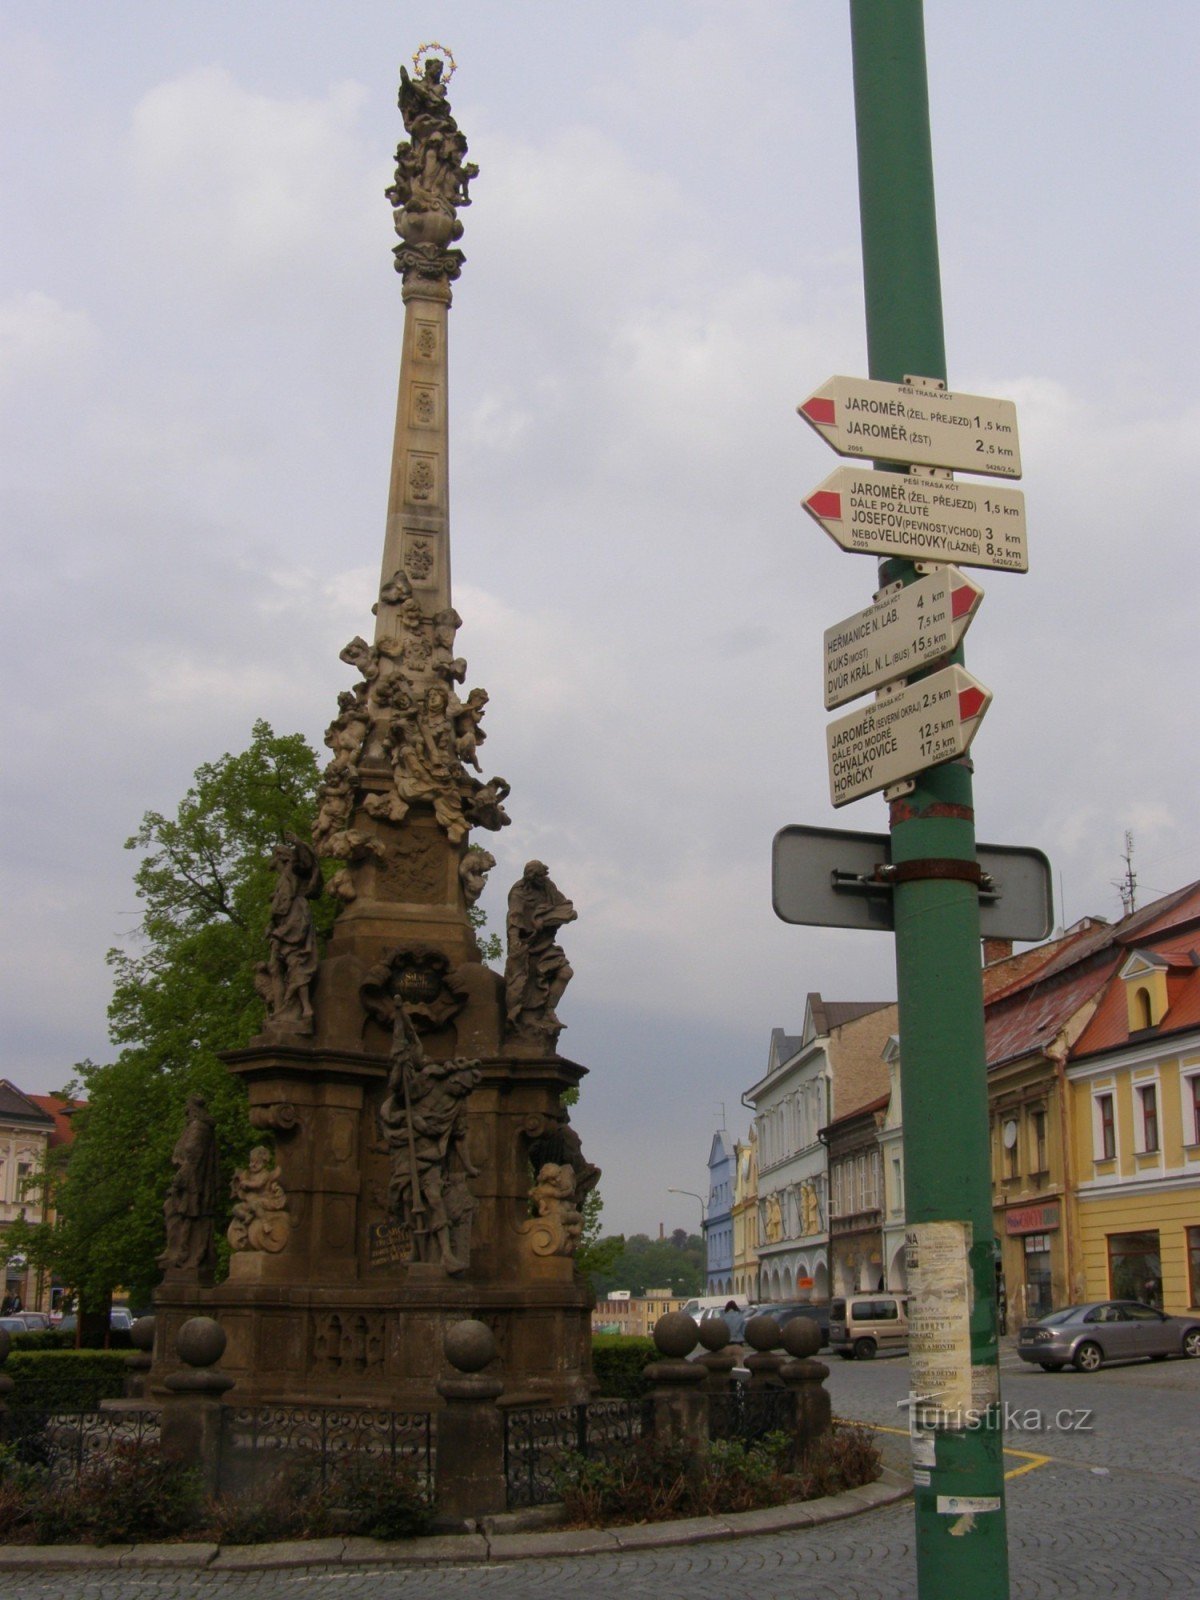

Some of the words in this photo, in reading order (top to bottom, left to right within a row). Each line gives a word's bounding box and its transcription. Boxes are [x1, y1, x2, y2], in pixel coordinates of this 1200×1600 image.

[915, 390, 938, 398] TRASA
[845, 397, 906, 417] JAROMĚŘ
[906, 408, 928, 420] (ŽEL.
[930, 412, 972, 428] PŘEJEZD)
[996, 422, 1011, 432] km
[847, 421, 907, 441] JAROMĚŘ
[910, 432, 932, 446] (ŽST)
[976, 440, 995, 454] 2,5
[998, 446, 1013, 456] km
[851, 482, 906, 500] JAROMĚŘ
[908, 491, 930, 502] (ŽEL.
[933, 495, 976, 512] PŘEJEZD)
[984, 500, 1000, 514] 1,5
[1004, 506, 1019, 516] km
[922, 480, 944, 488] TRASA
[850, 497, 877, 510] DÁLE
[880, 502, 895, 512] PO
[897, 502, 929, 516] ŽLUTÉ
[852, 510, 902, 528] JOSEFOV
[986, 528, 993, 540] 3
[1005, 533, 1020, 544] km
[878, 528, 947, 549] VELICHOVKY
[986, 543, 1002, 557] 8,5
[1006, 548, 1021, 559] km
[828, 621, 870, 655] HEŘMANICE
[882, 608, 899, 628] LAB.
[917, 595, 924, 608] 4
[932, 591, 944, 603] km
[828, 653, 848, 674] KUKS
[918, 616, 931, 630] 7,5
[933, 612, 945, 623] km
[828, 673, 848, 694] DVŮR
[851, 661, 873, 682] KRÁL.
[875, 658, 883, 671] N.
[912, 636, 932, 653] 15,5
[934, 633, 946, 644] km
[832, 717, 875, 749] JAROMĚŘ
[923, 694, 936, 708] 2,5
[939, 690, 951, 701] km
[877, 697, 893, 710] TRASA
[832, 746, 851, 762] DÁLE
[853, 742, 863, 753] PO
[865, 728, 892, 748] MODRÉ
[833, 738, 898, 776] CHVALKOVICE
[919, 723, 939, 739] 12,5
[941, 720, 954, 730] km
[834, 766, 874, 793] HOŘIČKY
[920, 741, 940, 756] 17,5
[943, 737, 955, 747] km
